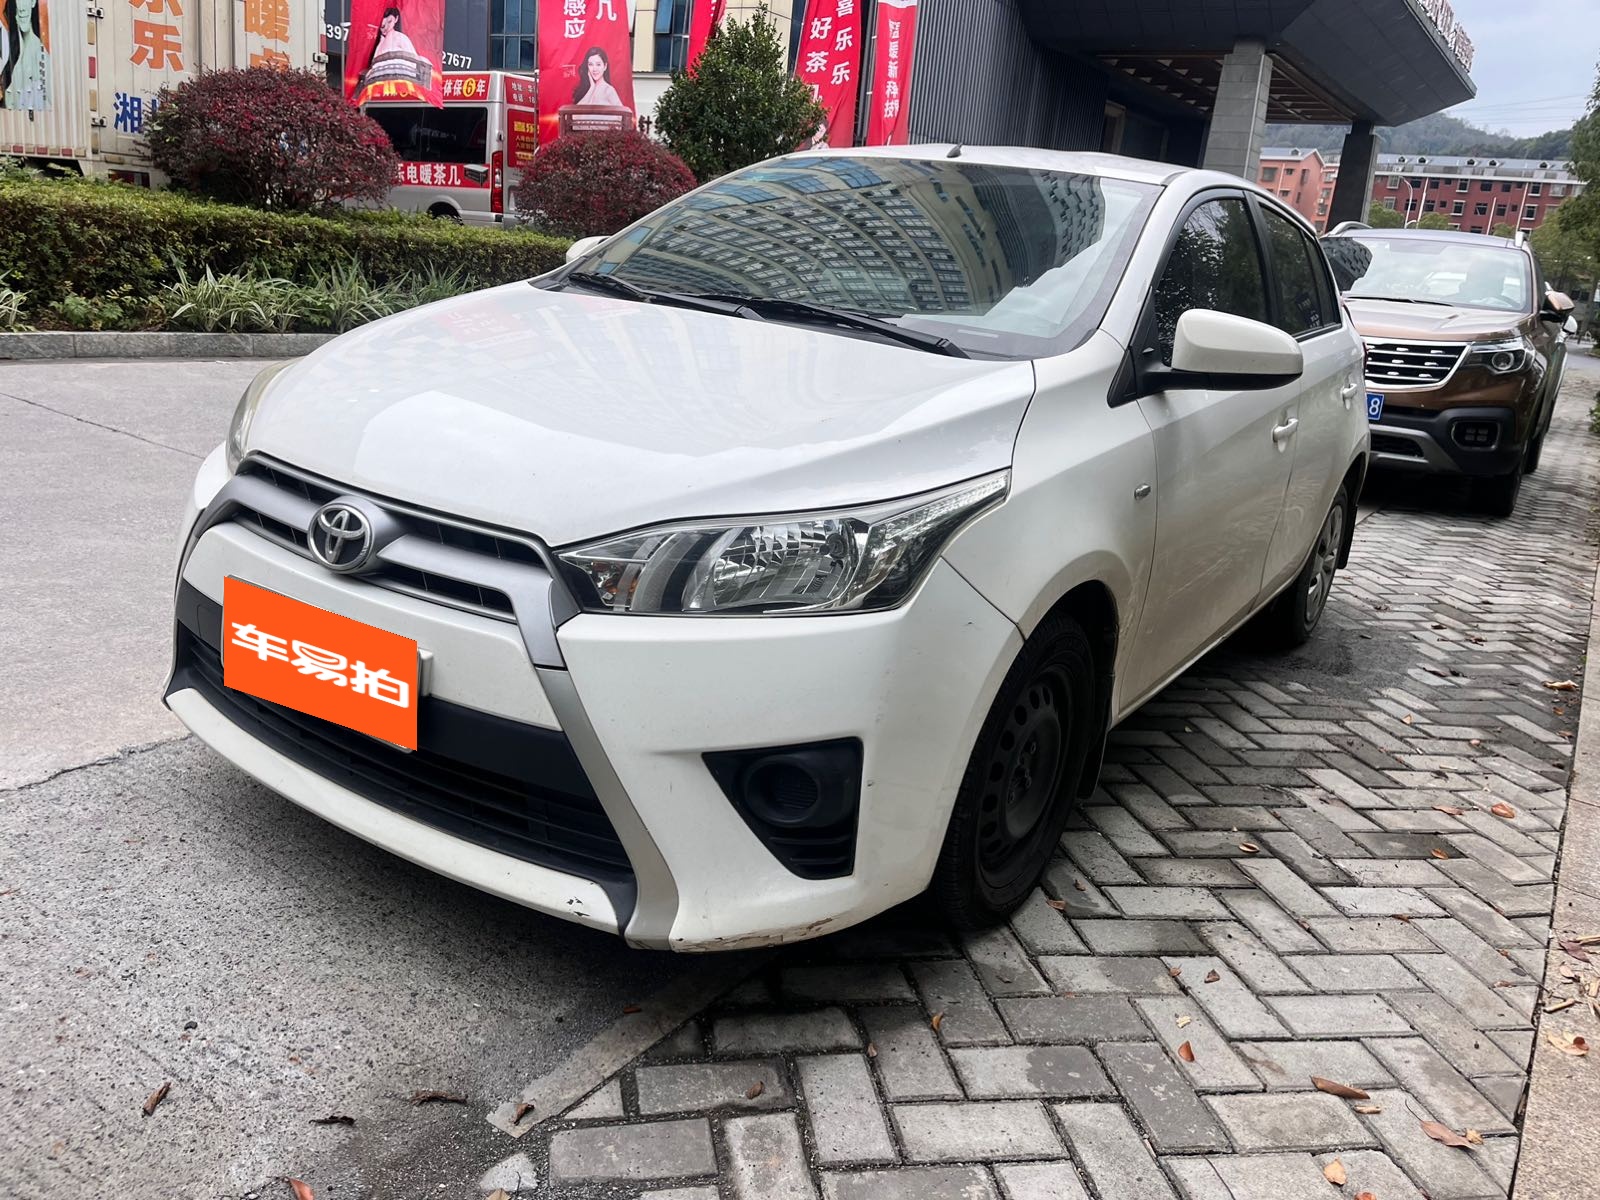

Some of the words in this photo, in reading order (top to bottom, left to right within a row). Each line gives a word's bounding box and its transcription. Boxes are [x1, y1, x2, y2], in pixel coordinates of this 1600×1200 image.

[563, 0, 586, 39] 感应
[830, 0, 855, 85] 喜乐乐
[1368, 397, 1381, 416] 8
